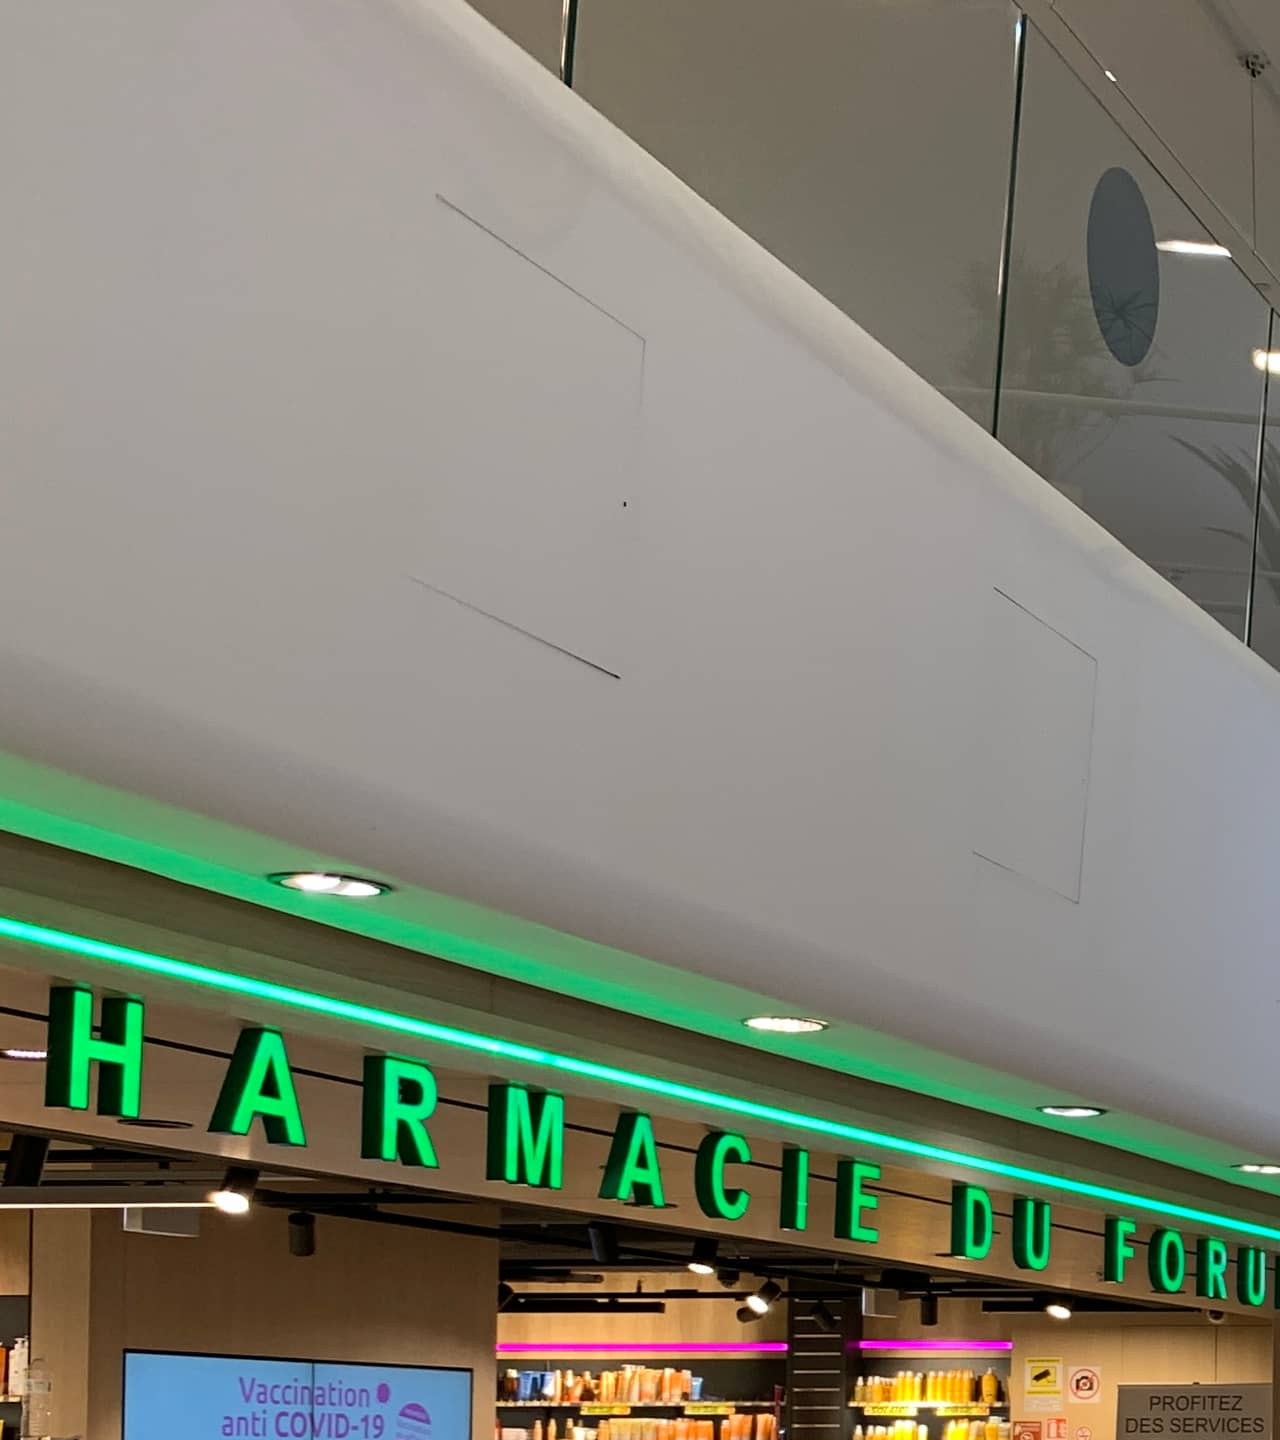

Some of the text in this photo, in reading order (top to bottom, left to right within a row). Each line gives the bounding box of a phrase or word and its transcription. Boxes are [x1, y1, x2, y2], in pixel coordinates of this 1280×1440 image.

[951, 1182, 1052, 1271] DU
[239, 1376, 371, 1408] Vaccination
[1150, 1395, 1243, 1411] PROFITEZ
[222, 1409, 267, 1437] anti
[274, 1410, 385, 1439] COVID-19
[1125, 1417, 1265, 1433] DES SERVICES
